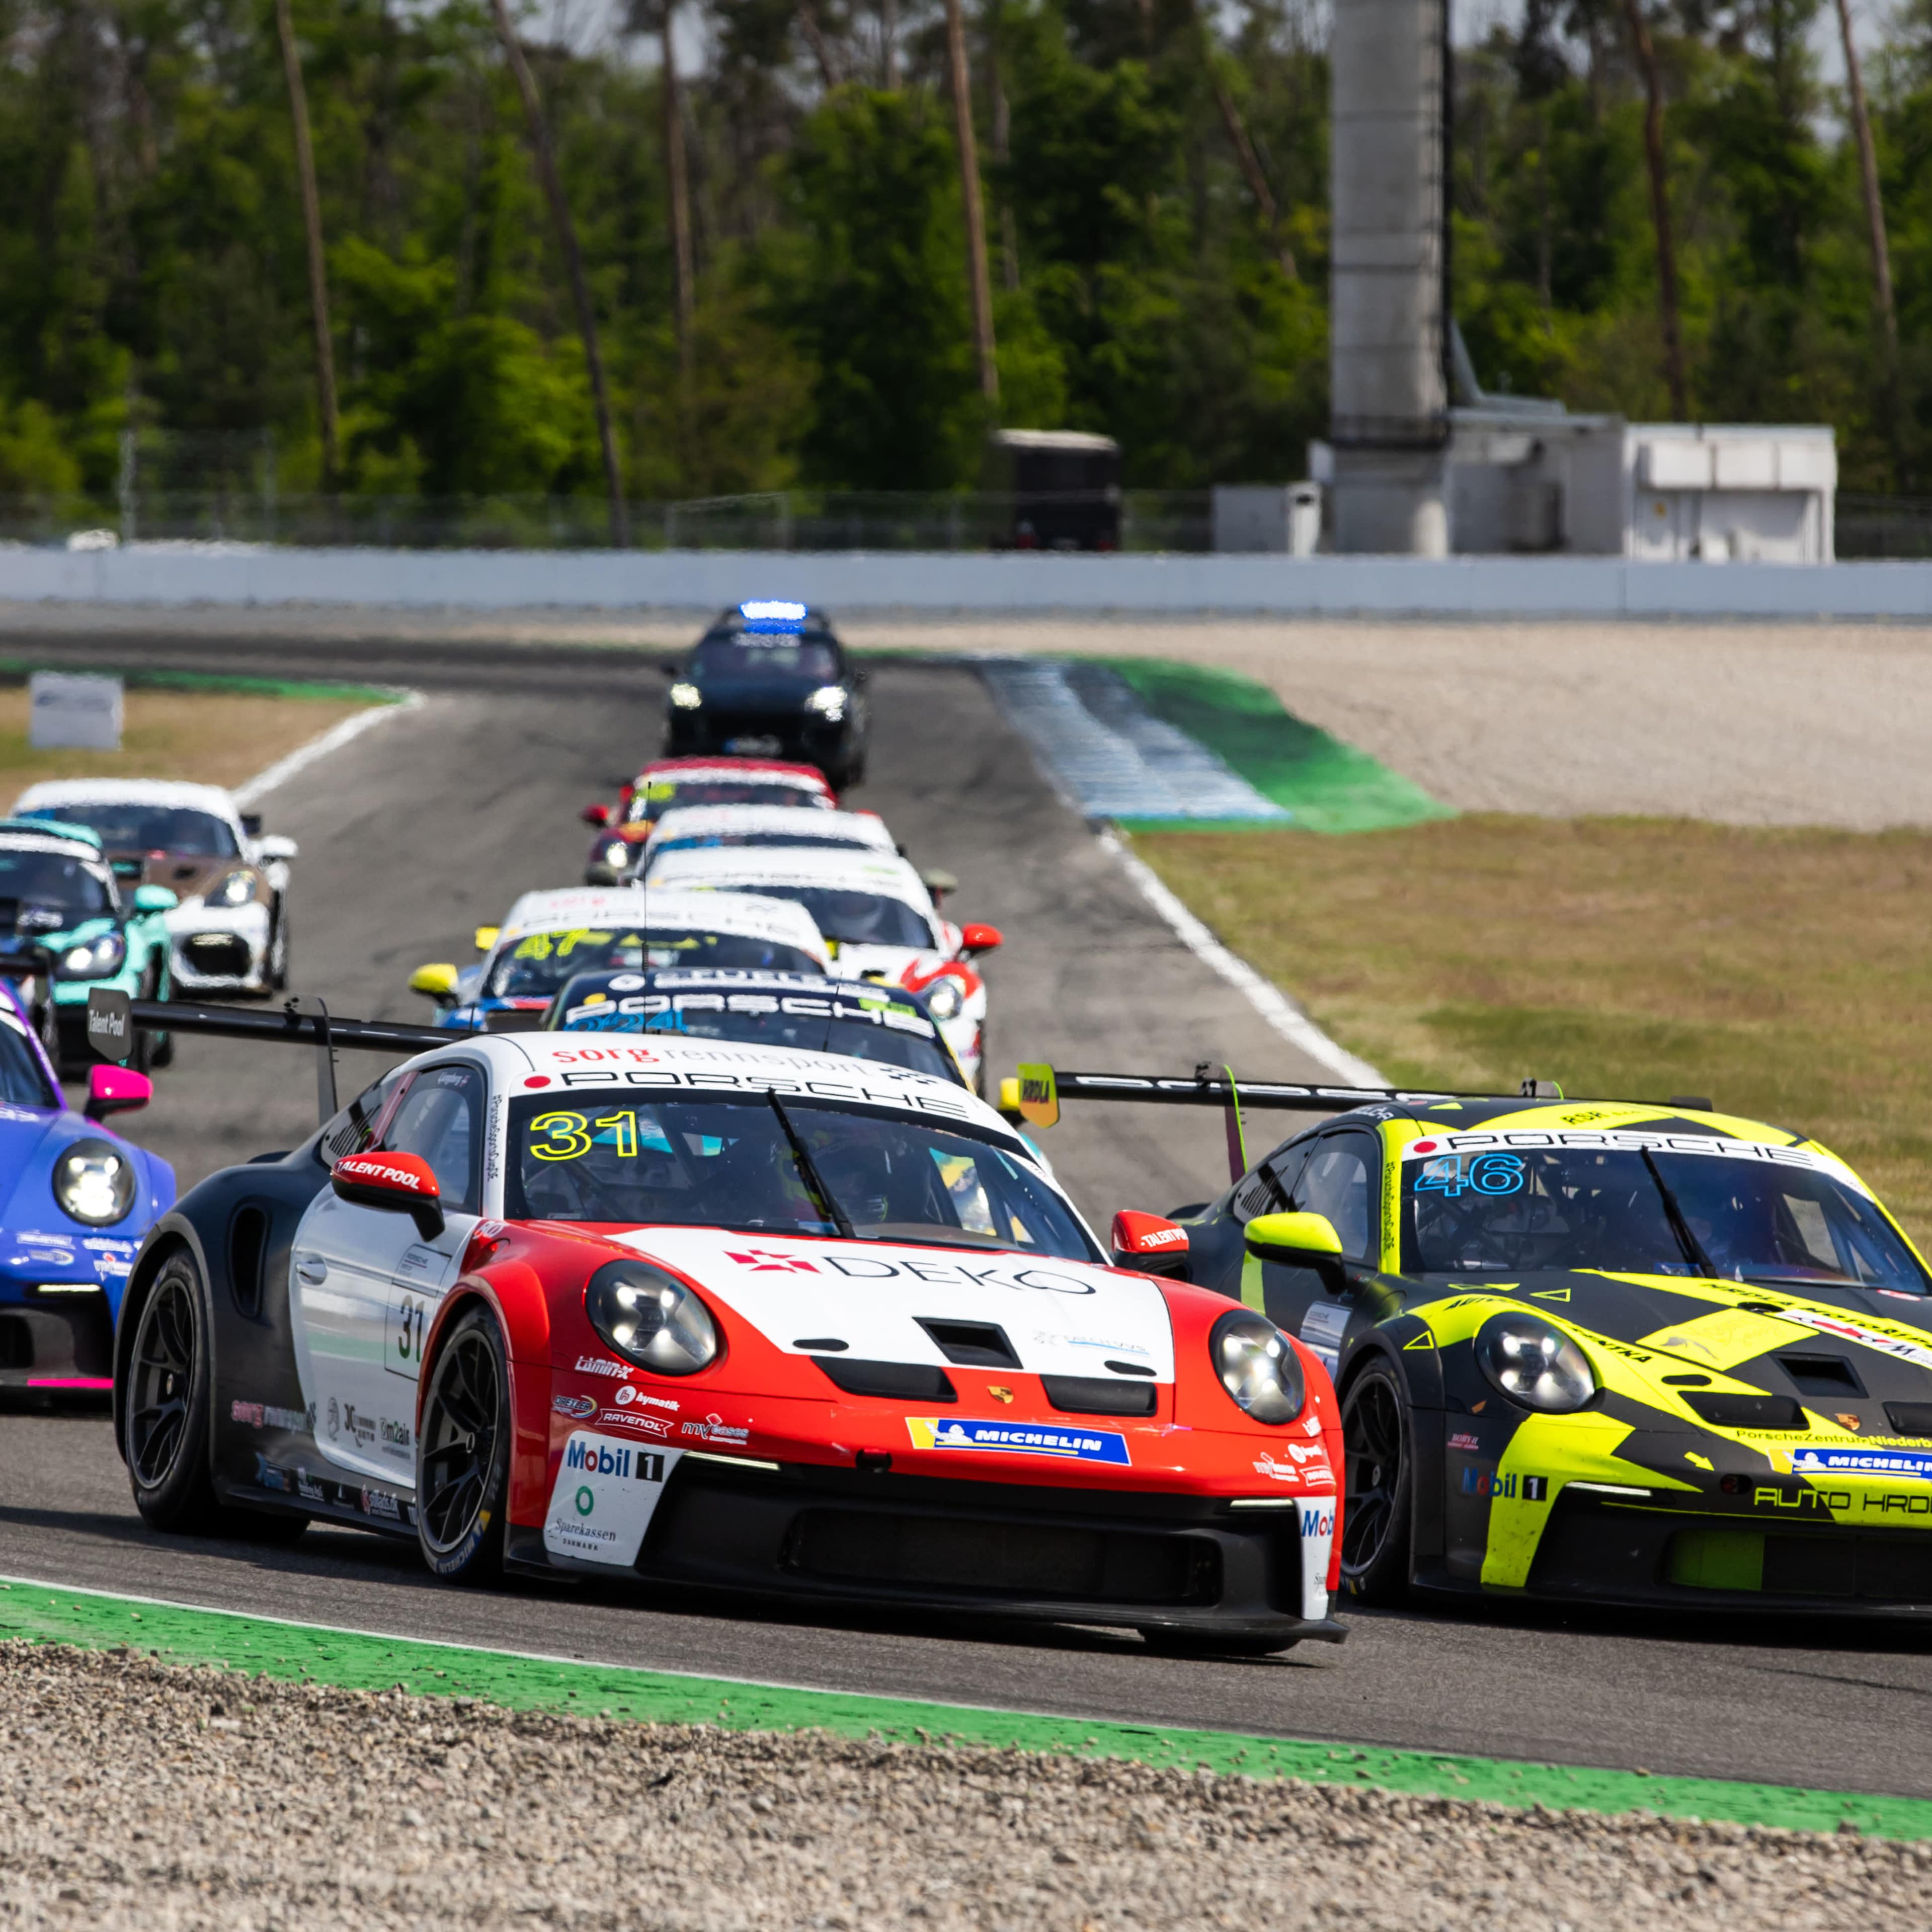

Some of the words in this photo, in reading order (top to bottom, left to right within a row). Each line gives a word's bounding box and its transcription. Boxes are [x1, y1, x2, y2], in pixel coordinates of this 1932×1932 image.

[514, 928, 589, 961] 47
[88, 1009, 109, 1034] Talent
[109, 1011, 125, 1038] Pool
[567, 994, 935, 1038] PORSCHE
[552, 1048, 660, 1063] sorg
[665, 1048, 869, 1077] rennsport
[561, 1071, 970, 1119] PORSCHE
[530, 1110, 637, 1161] 31
[1447, 1133, 1813, 1166] PORSCHE
[337, 1161, 384, 1176] TALENT
[382, 1167, 420, 1190] POOL
[1414, 1153, 1523, 1197] 46
[1141, 1229, 1176, 1247] TALENT
[823, 1256, 1096, 1296] DEKO
[398, 1295, 425, 1363] 31
[554, 1395, 591, 1411] DREXLER
[636, 1392, 681, 1412] hymatik
[603, 1412, 665, 1431] RAVENOL
[975, 1429, 1102, 1453] MICHELIN
[567, 1440, 631, 1478] Mobil
[1462, 1467, 1516, 1498] Mobil
[1754, 1487, 1851, 1510] AUTO
[555, 1517, 616, 1542] Sparekassen
[562, 1538, 599, 1552] DANMARK
